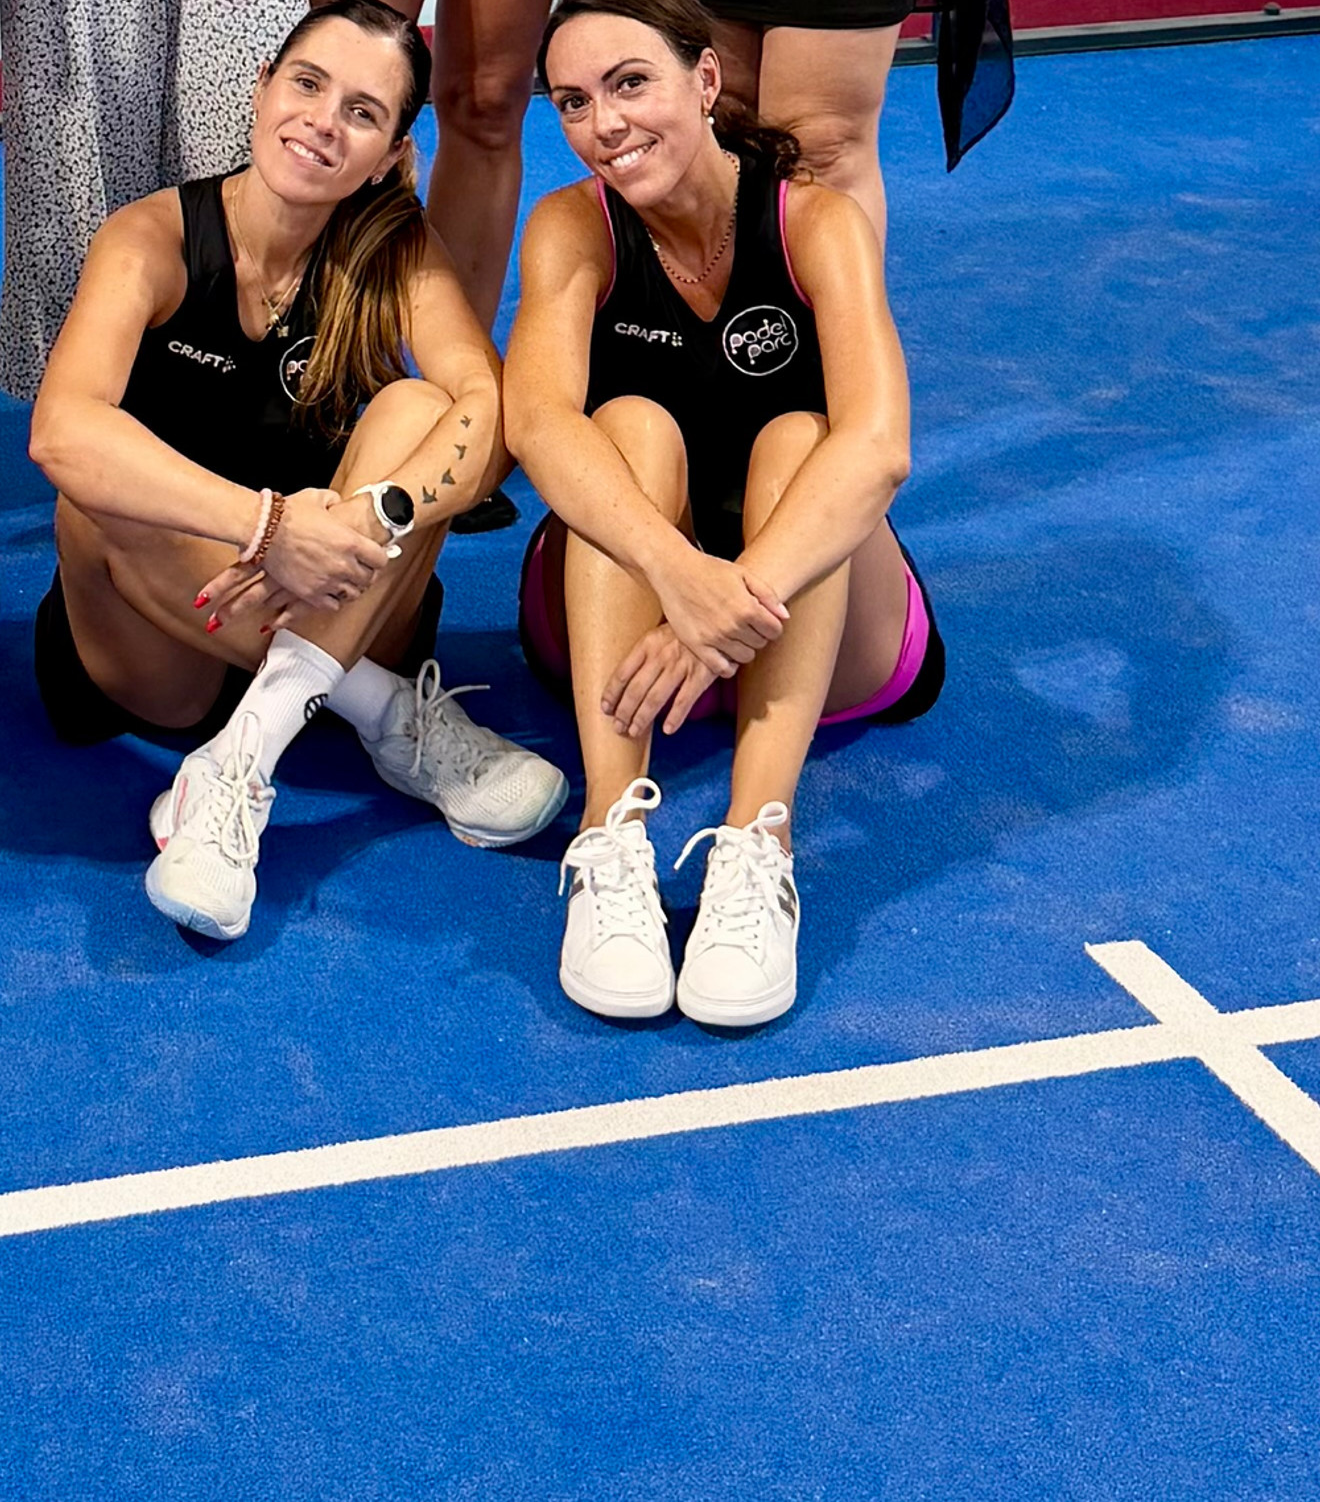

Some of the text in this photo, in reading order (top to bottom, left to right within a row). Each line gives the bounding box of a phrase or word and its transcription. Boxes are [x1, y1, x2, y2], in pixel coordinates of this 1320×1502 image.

[615, 322, 671, 343] CRAFT
[729, 314, 787, 355] padel
[168, 340, 225, 368] CRAFT
[747, 332, 792, 365] parc
